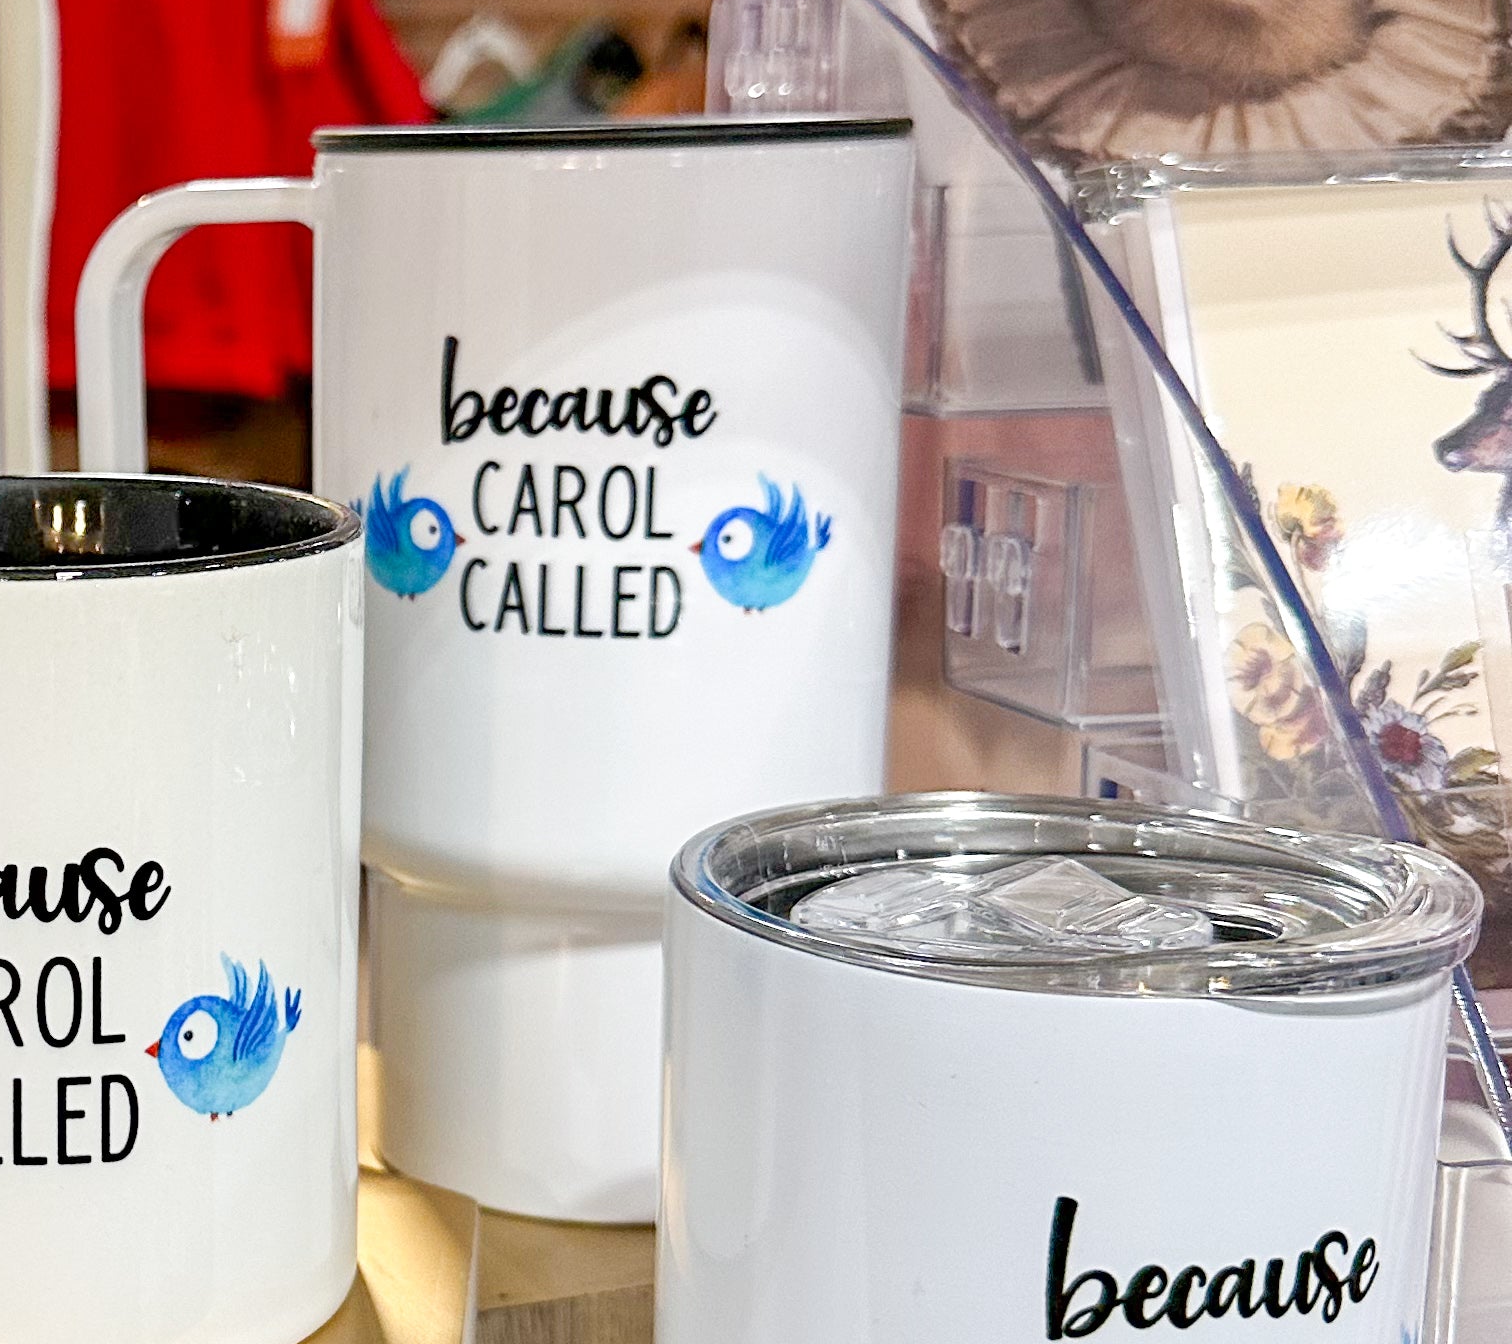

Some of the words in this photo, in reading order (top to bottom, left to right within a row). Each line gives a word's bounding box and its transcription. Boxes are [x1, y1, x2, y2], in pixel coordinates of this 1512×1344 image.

[440, 336, 719, 448] because
[472, 460, 674, 540] CAROL
[459, 558, 683, 639] CALLED
[1045, 1196, 1380, 1341] because
